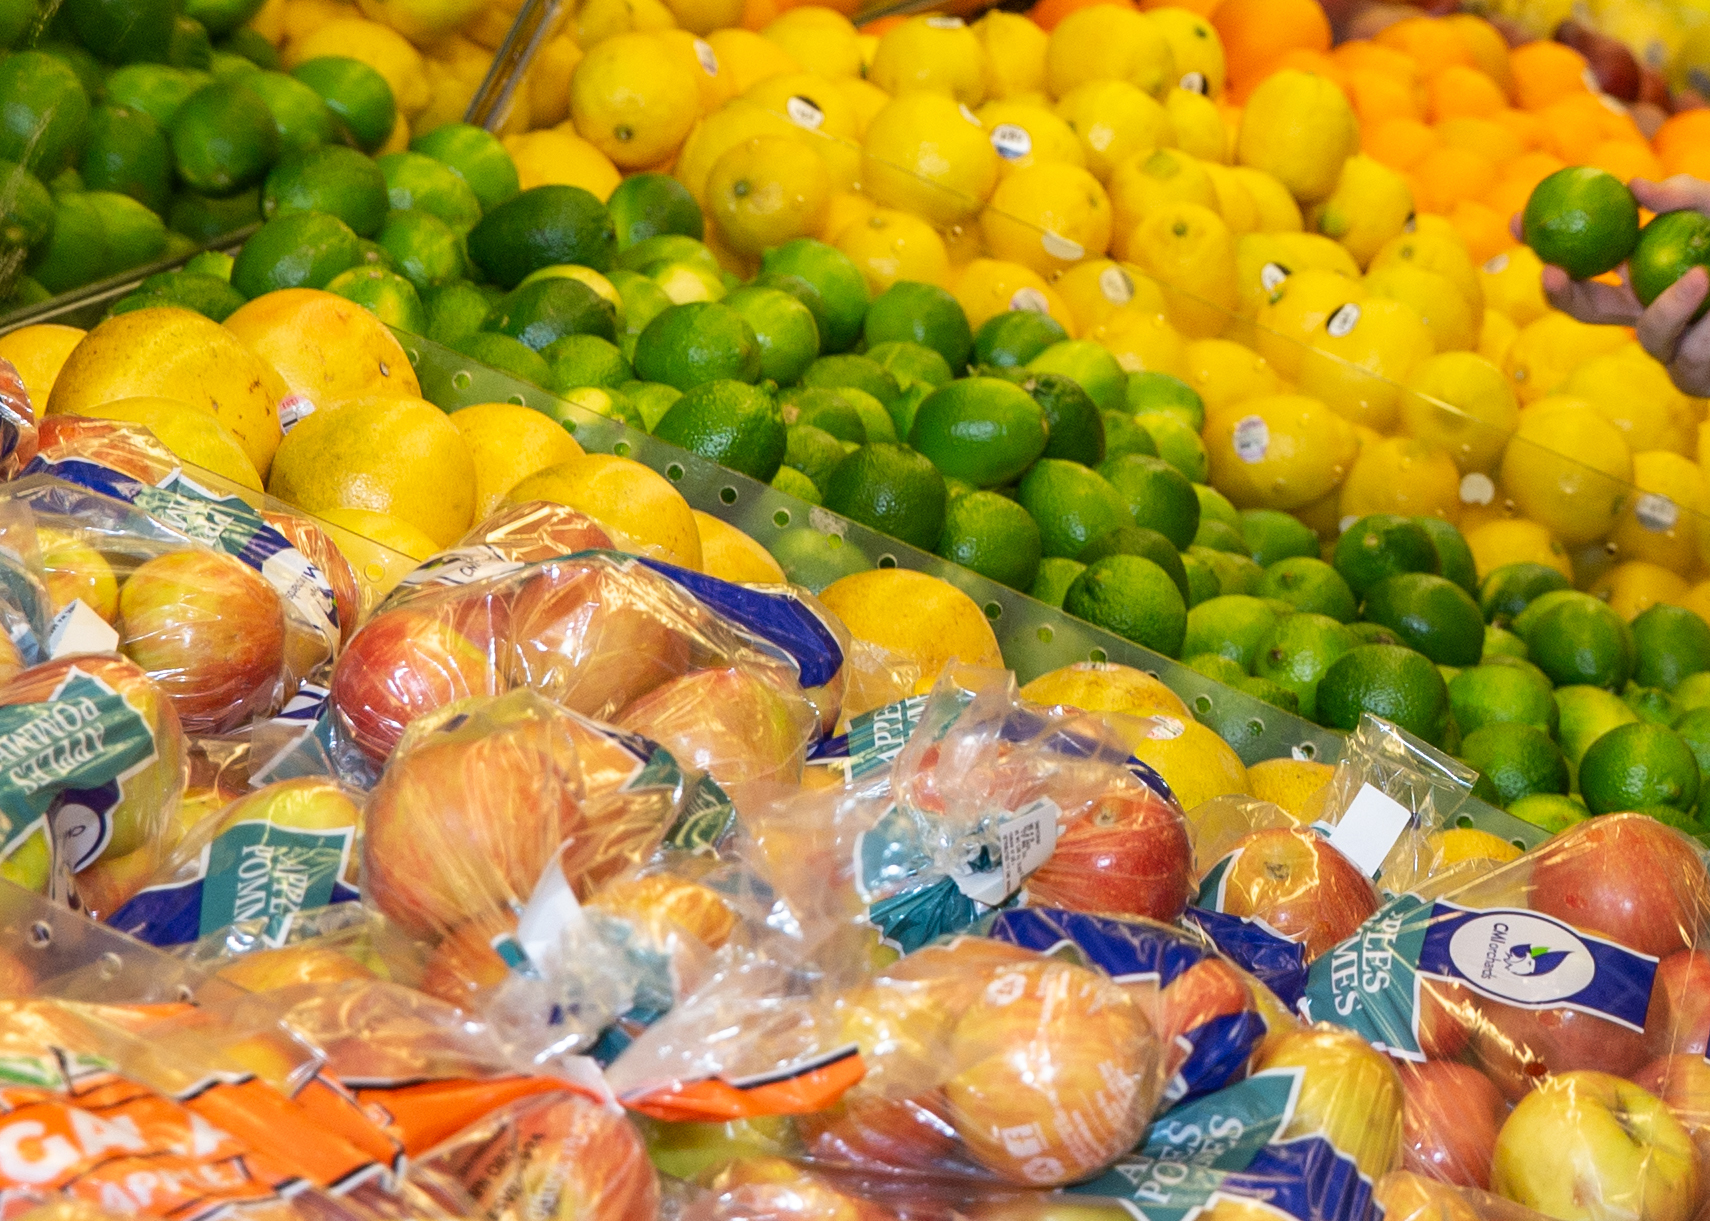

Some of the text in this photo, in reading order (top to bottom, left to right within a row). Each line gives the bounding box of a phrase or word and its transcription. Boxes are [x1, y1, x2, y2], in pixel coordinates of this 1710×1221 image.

[10, 723, 105, 796] APPLES
[1481, 922, 1509, 979] CMI orchards
